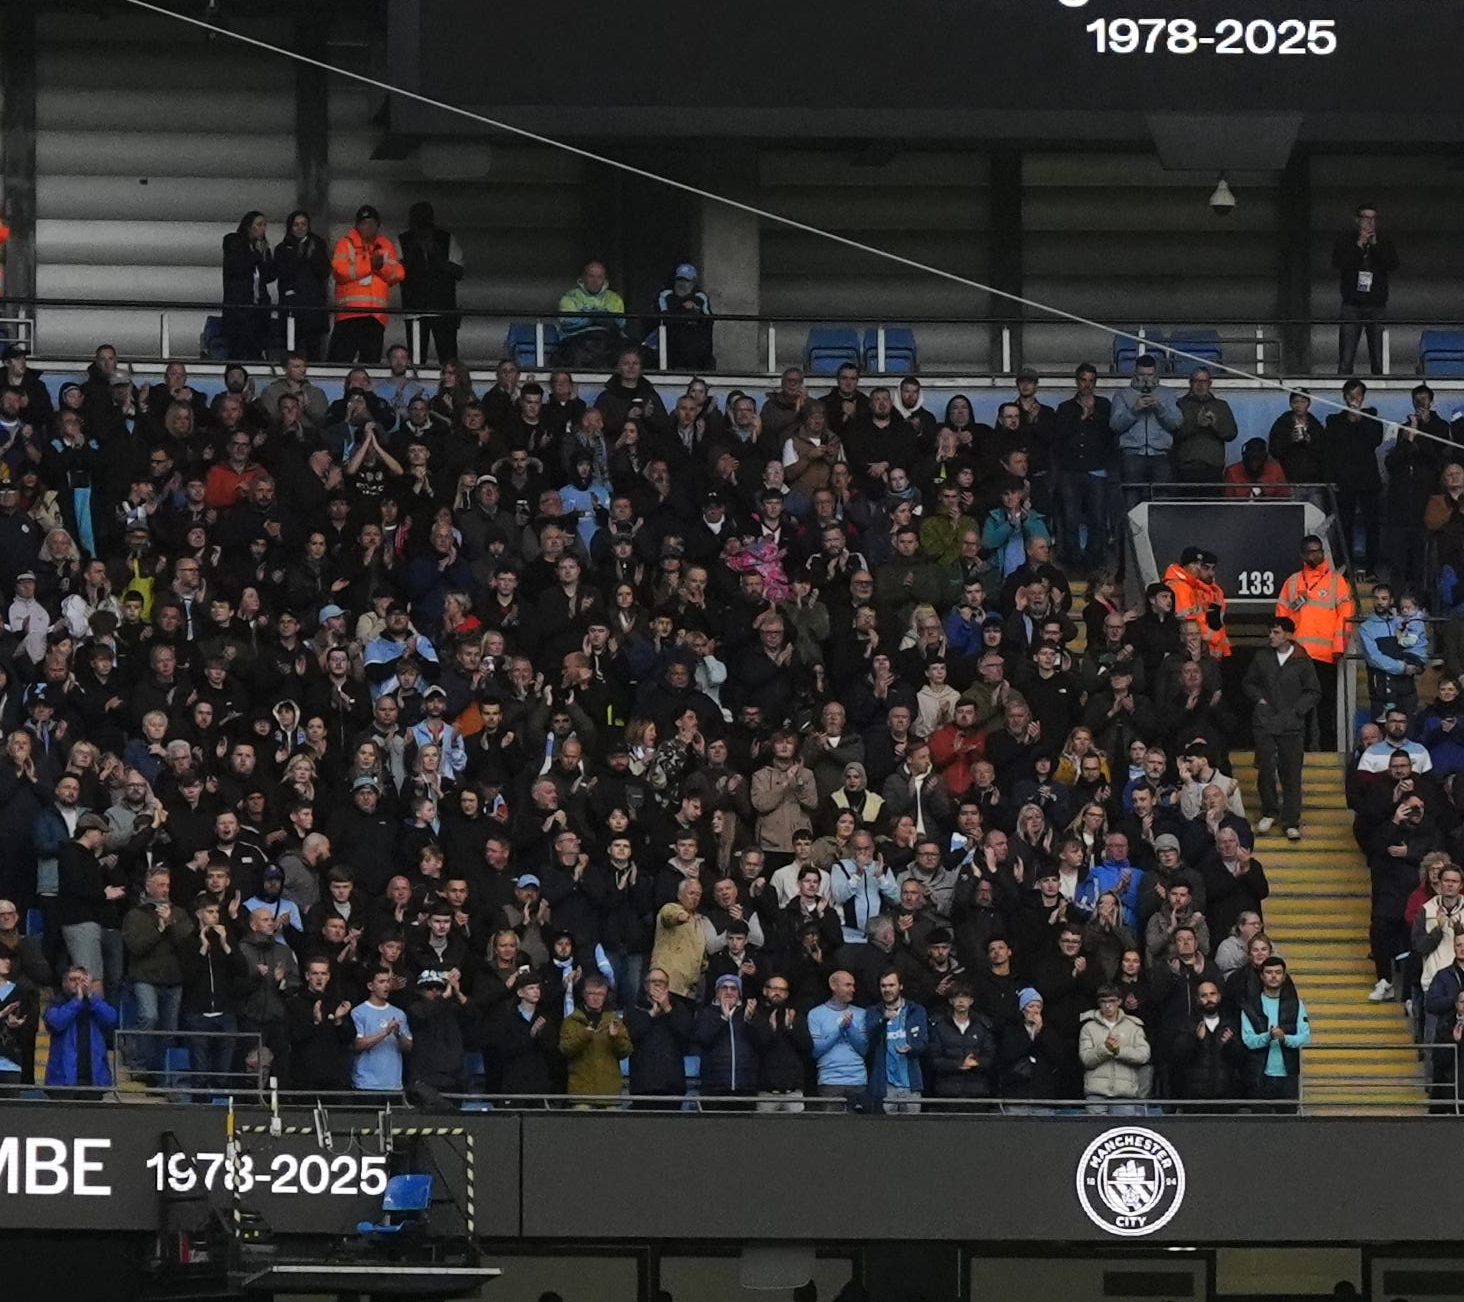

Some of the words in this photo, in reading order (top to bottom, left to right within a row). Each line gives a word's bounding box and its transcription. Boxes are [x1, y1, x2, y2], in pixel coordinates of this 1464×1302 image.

[1086, 18, 1337, 55] 1978-2025
[1238, 570, 1275, 596] 133
[1089, 1135, 1173, 1169] MANCHESTER
[145, 1151, 389, 1196] 1978-2025
[1115, 1215, 1147, 1228] CITY
